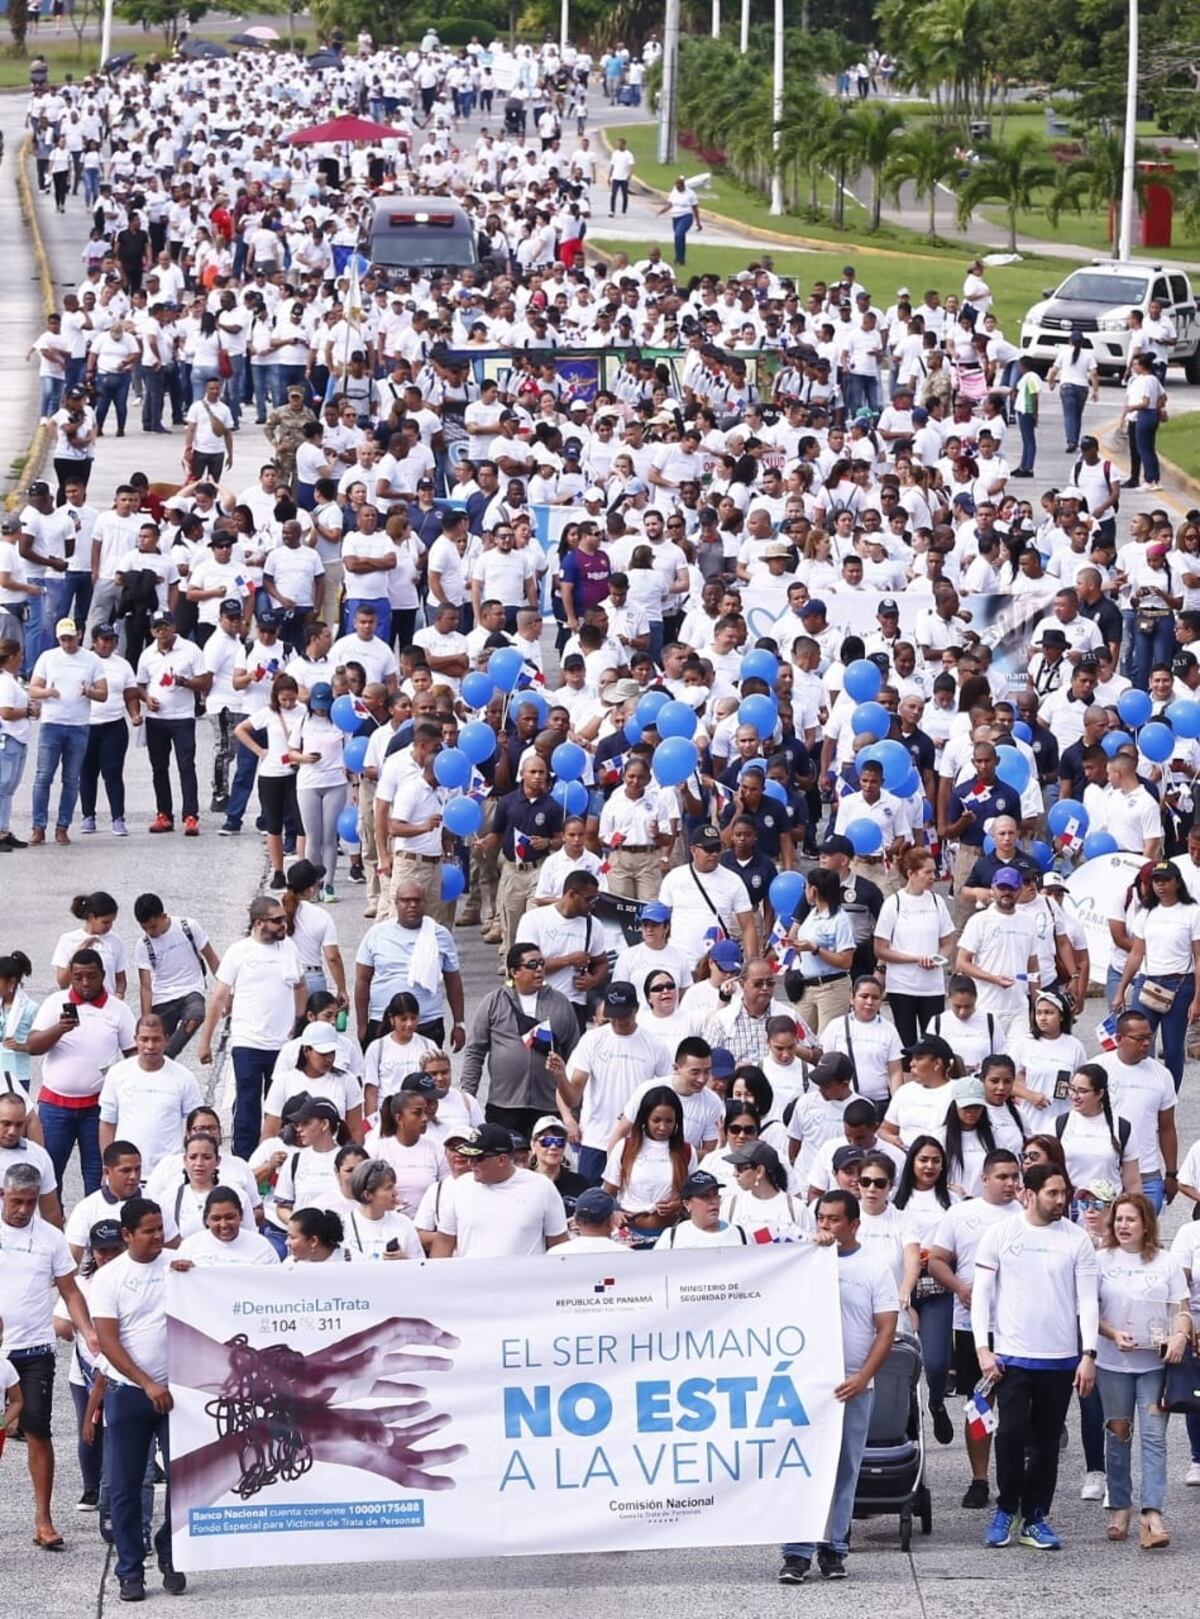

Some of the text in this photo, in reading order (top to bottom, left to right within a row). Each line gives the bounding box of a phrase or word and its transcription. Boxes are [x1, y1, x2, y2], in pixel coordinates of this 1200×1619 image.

[680, 1283, 739, 1293] MINISTERIO DE
[556, 1297, 600, 1307] REPÚBLICA
[603, 1297, 614, 1305] DE
[680, 1290, 761, 1303] SEGURIDAD PÚBLICA
[232, 1298, 370, 1316] #DenunciaLaTrata
[271, 1317, 341, 1333] 104 311
[502, 1325, 806, 1368] EL SER HUMANO
[503, 1360, 811, 1438] NO ESTÁ
[499, 1437, 812, 1492] A LA VENTA
[609, 1495, 714, 1511] Comisión Nacional
[192, 1511, 222, 1521] Banco
[224, 1507, 268, 1519] Nacional
[269, 1508, 302, 1517] cuenta
[304, 1506, 345, 1516] corriente
[192, 1524, 222, 1534] Fondo
[223, 1521, 262, 1534] Especial
[263, 1522, 284, 1532] para
[326, 1518, 340, 1528] de
[342, 1518, 363, 1527] Trata
[366, 1516, 379, 1527] de
[380, 1515, 421, 1526] Personas
